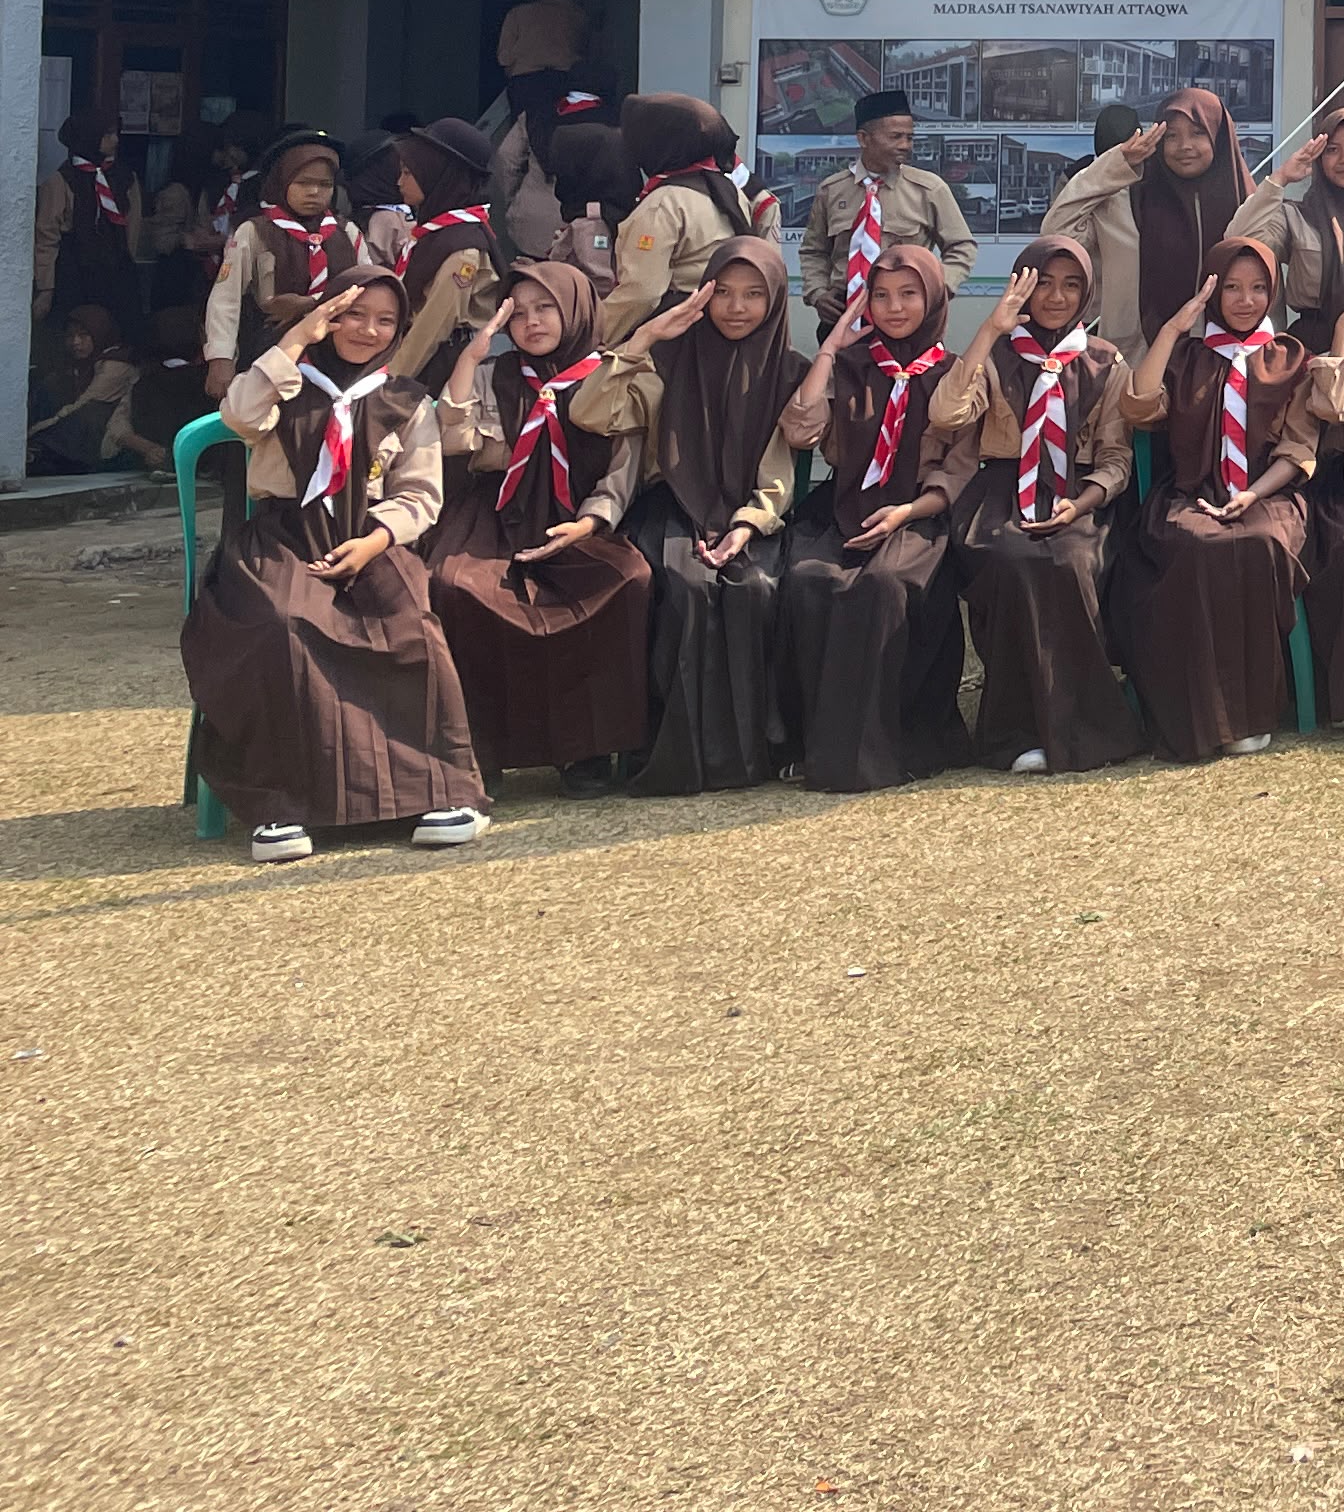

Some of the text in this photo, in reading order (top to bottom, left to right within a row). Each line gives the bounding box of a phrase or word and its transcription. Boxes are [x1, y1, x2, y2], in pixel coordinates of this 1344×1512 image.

[933, 3, 1188, 17] MADRASAH TSANAWIYAH ATTAQWA
